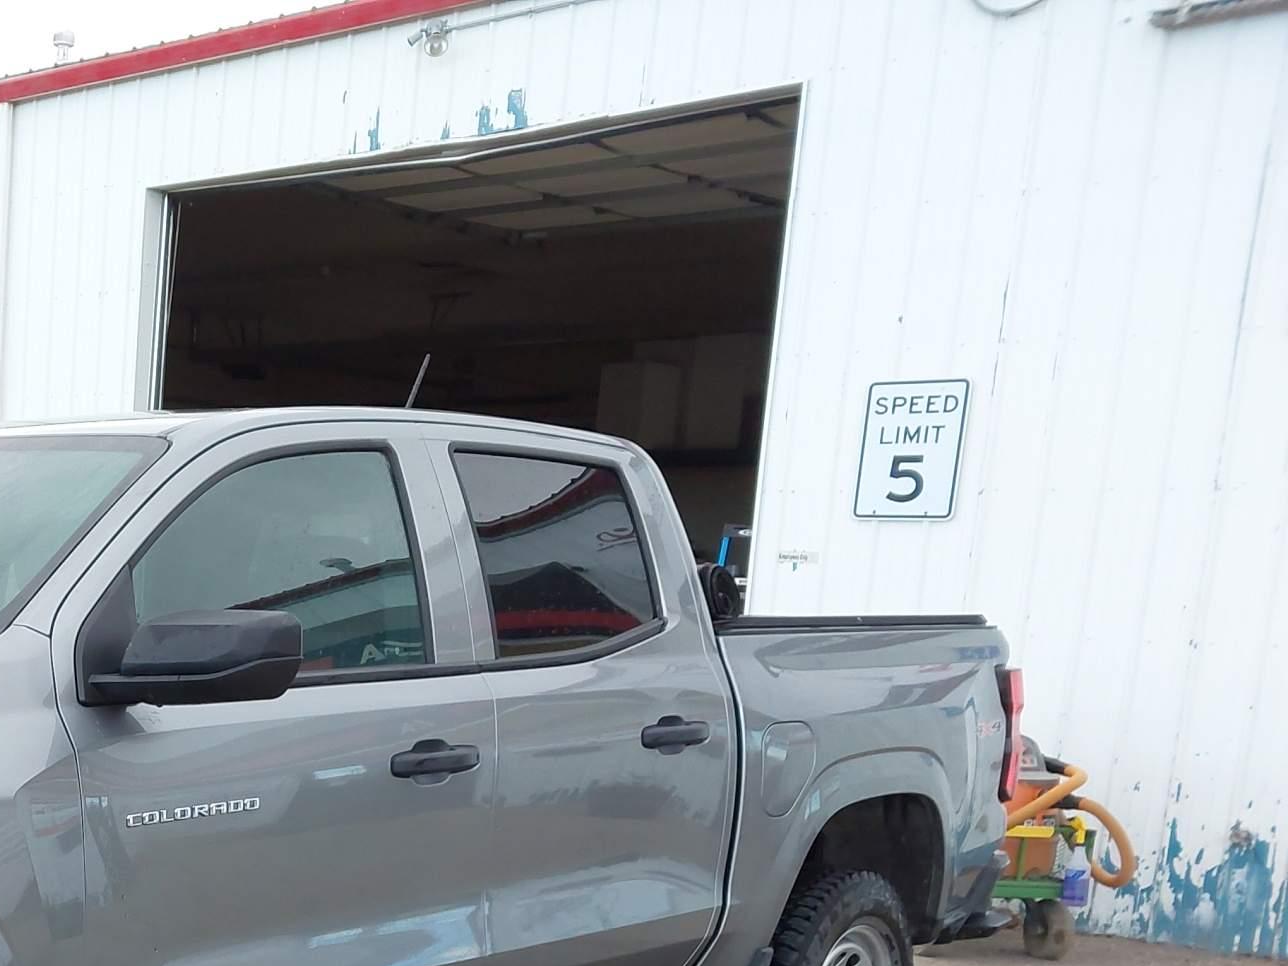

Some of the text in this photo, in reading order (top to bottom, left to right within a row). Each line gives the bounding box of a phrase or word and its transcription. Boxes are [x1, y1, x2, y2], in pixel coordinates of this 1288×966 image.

[874, 394, 959, 415] SPEED
[879, 425, 946, 444] LIMIT
[885, 454, 924, 503] 5
[126, 797, 260, 828] COLORADO
